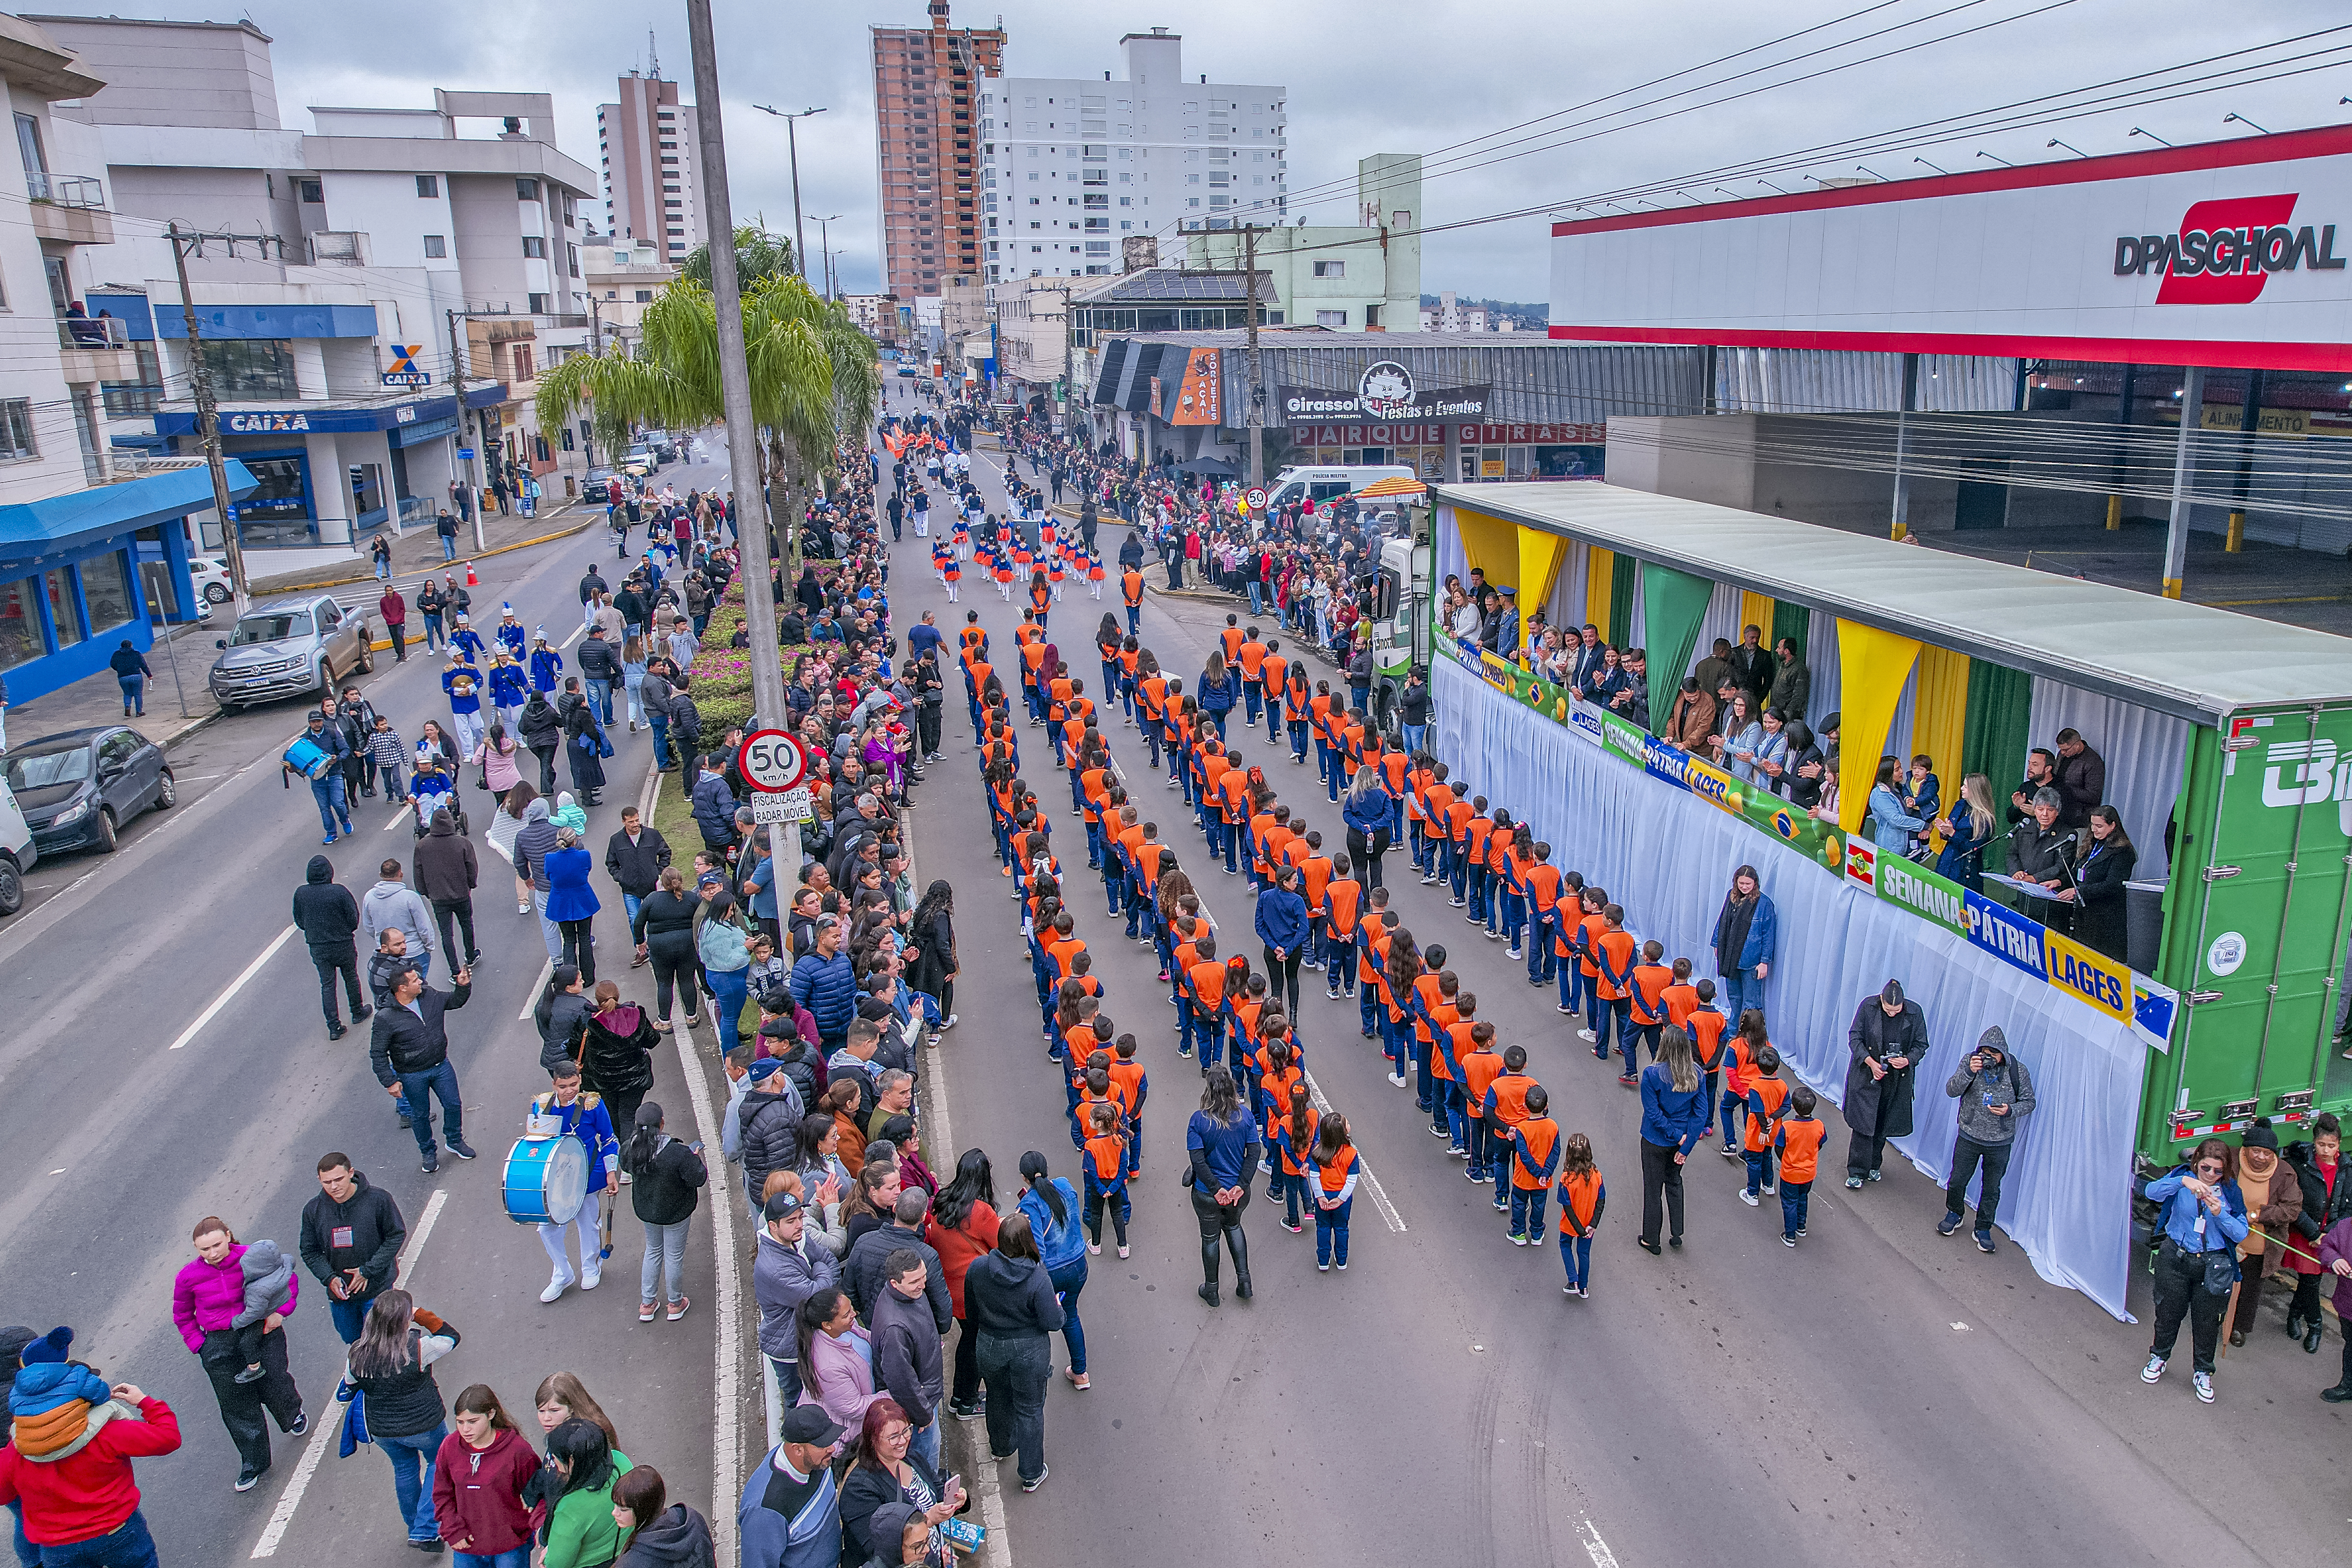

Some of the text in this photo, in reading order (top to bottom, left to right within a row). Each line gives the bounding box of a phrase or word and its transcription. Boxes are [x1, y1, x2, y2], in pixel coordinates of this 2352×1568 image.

[2114, 225, 2346, 275] DPASCHOAL
[386, 375, 427, 384] CAIXA
[1287, 397, 1359, 412] Girassol
[1382, 400, 1482, 420] Festas e Eventos
[231, 414, 309, 431] CAIXA
[2209, 411, 2302, 431] ALINHMENTO
[1296, 425, 1439, 443] PARQUE
[1249, 492, 1264, 502] 50
[1580, 714, 1600, 734] LAGES
[752, 743, 794, 772] 50
[763, 773, 788, 781] km/h
[754, 789, 807, 807] FISCALIZAÇÃO
[756, 805, 810, 822] RADAR MÓVEL
[1884, 864, 2124, 1012] SEMANA DA PÁTRIA LAGES
